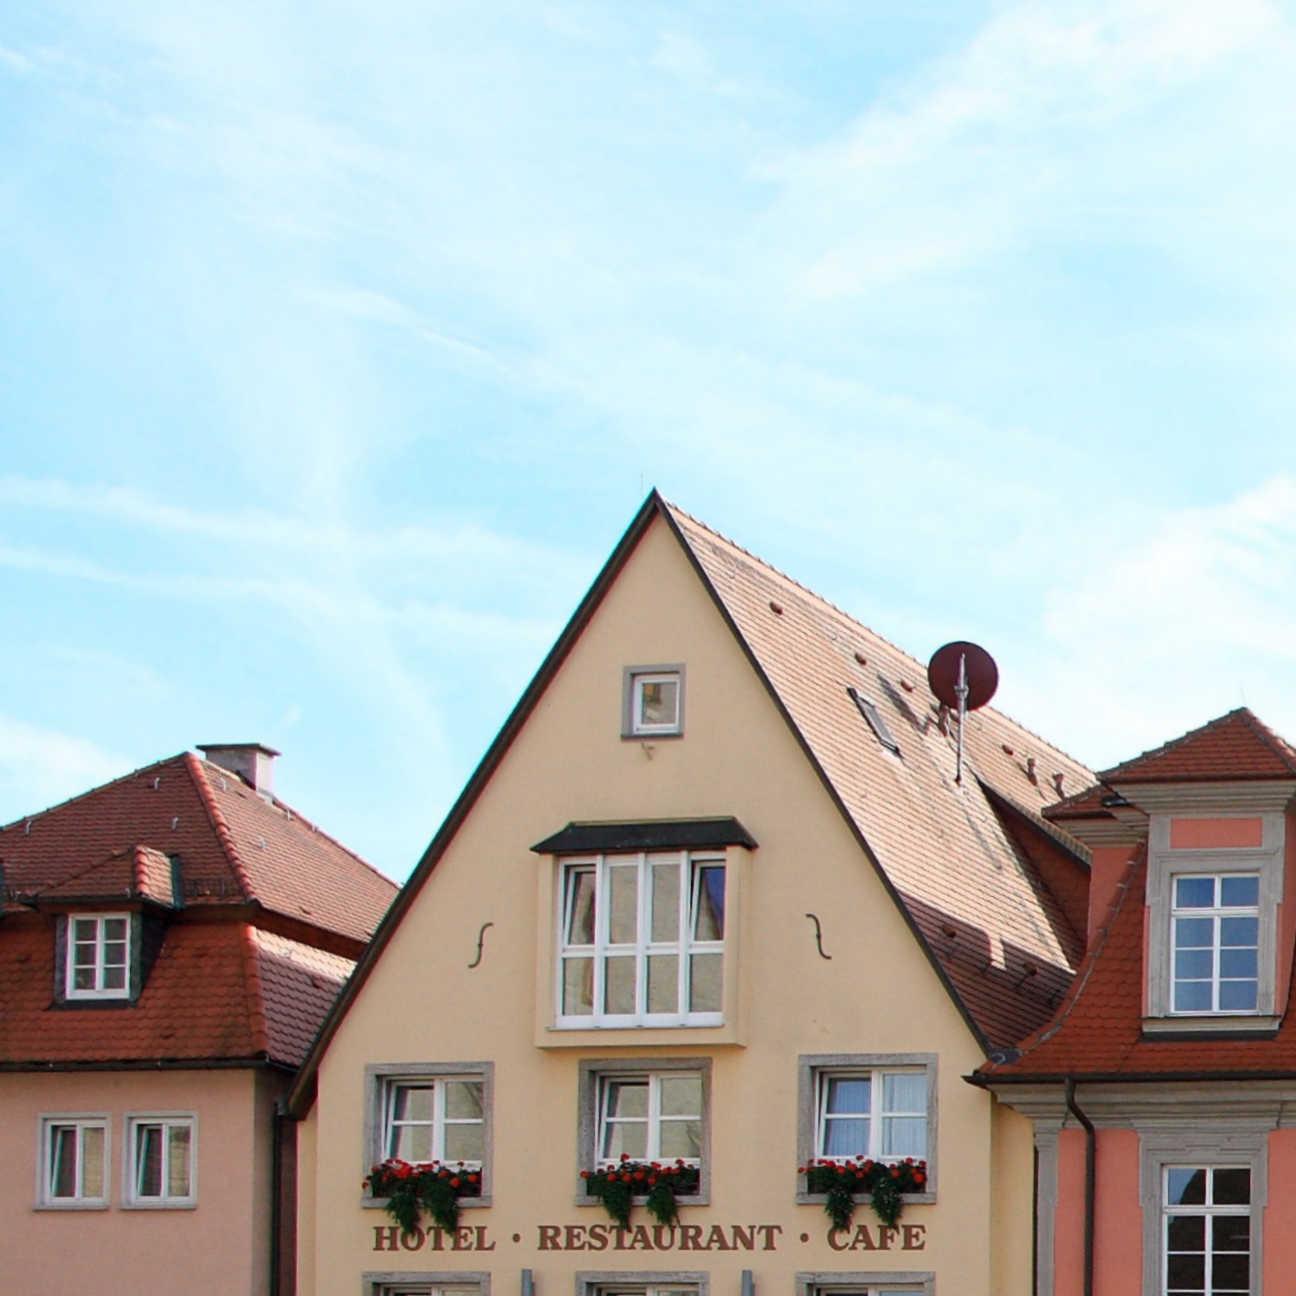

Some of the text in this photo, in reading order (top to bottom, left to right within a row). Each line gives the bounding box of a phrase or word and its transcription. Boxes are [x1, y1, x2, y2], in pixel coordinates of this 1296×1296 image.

[373, 1224, 926, 1251] HOTEL RESTAURANT CAFE
